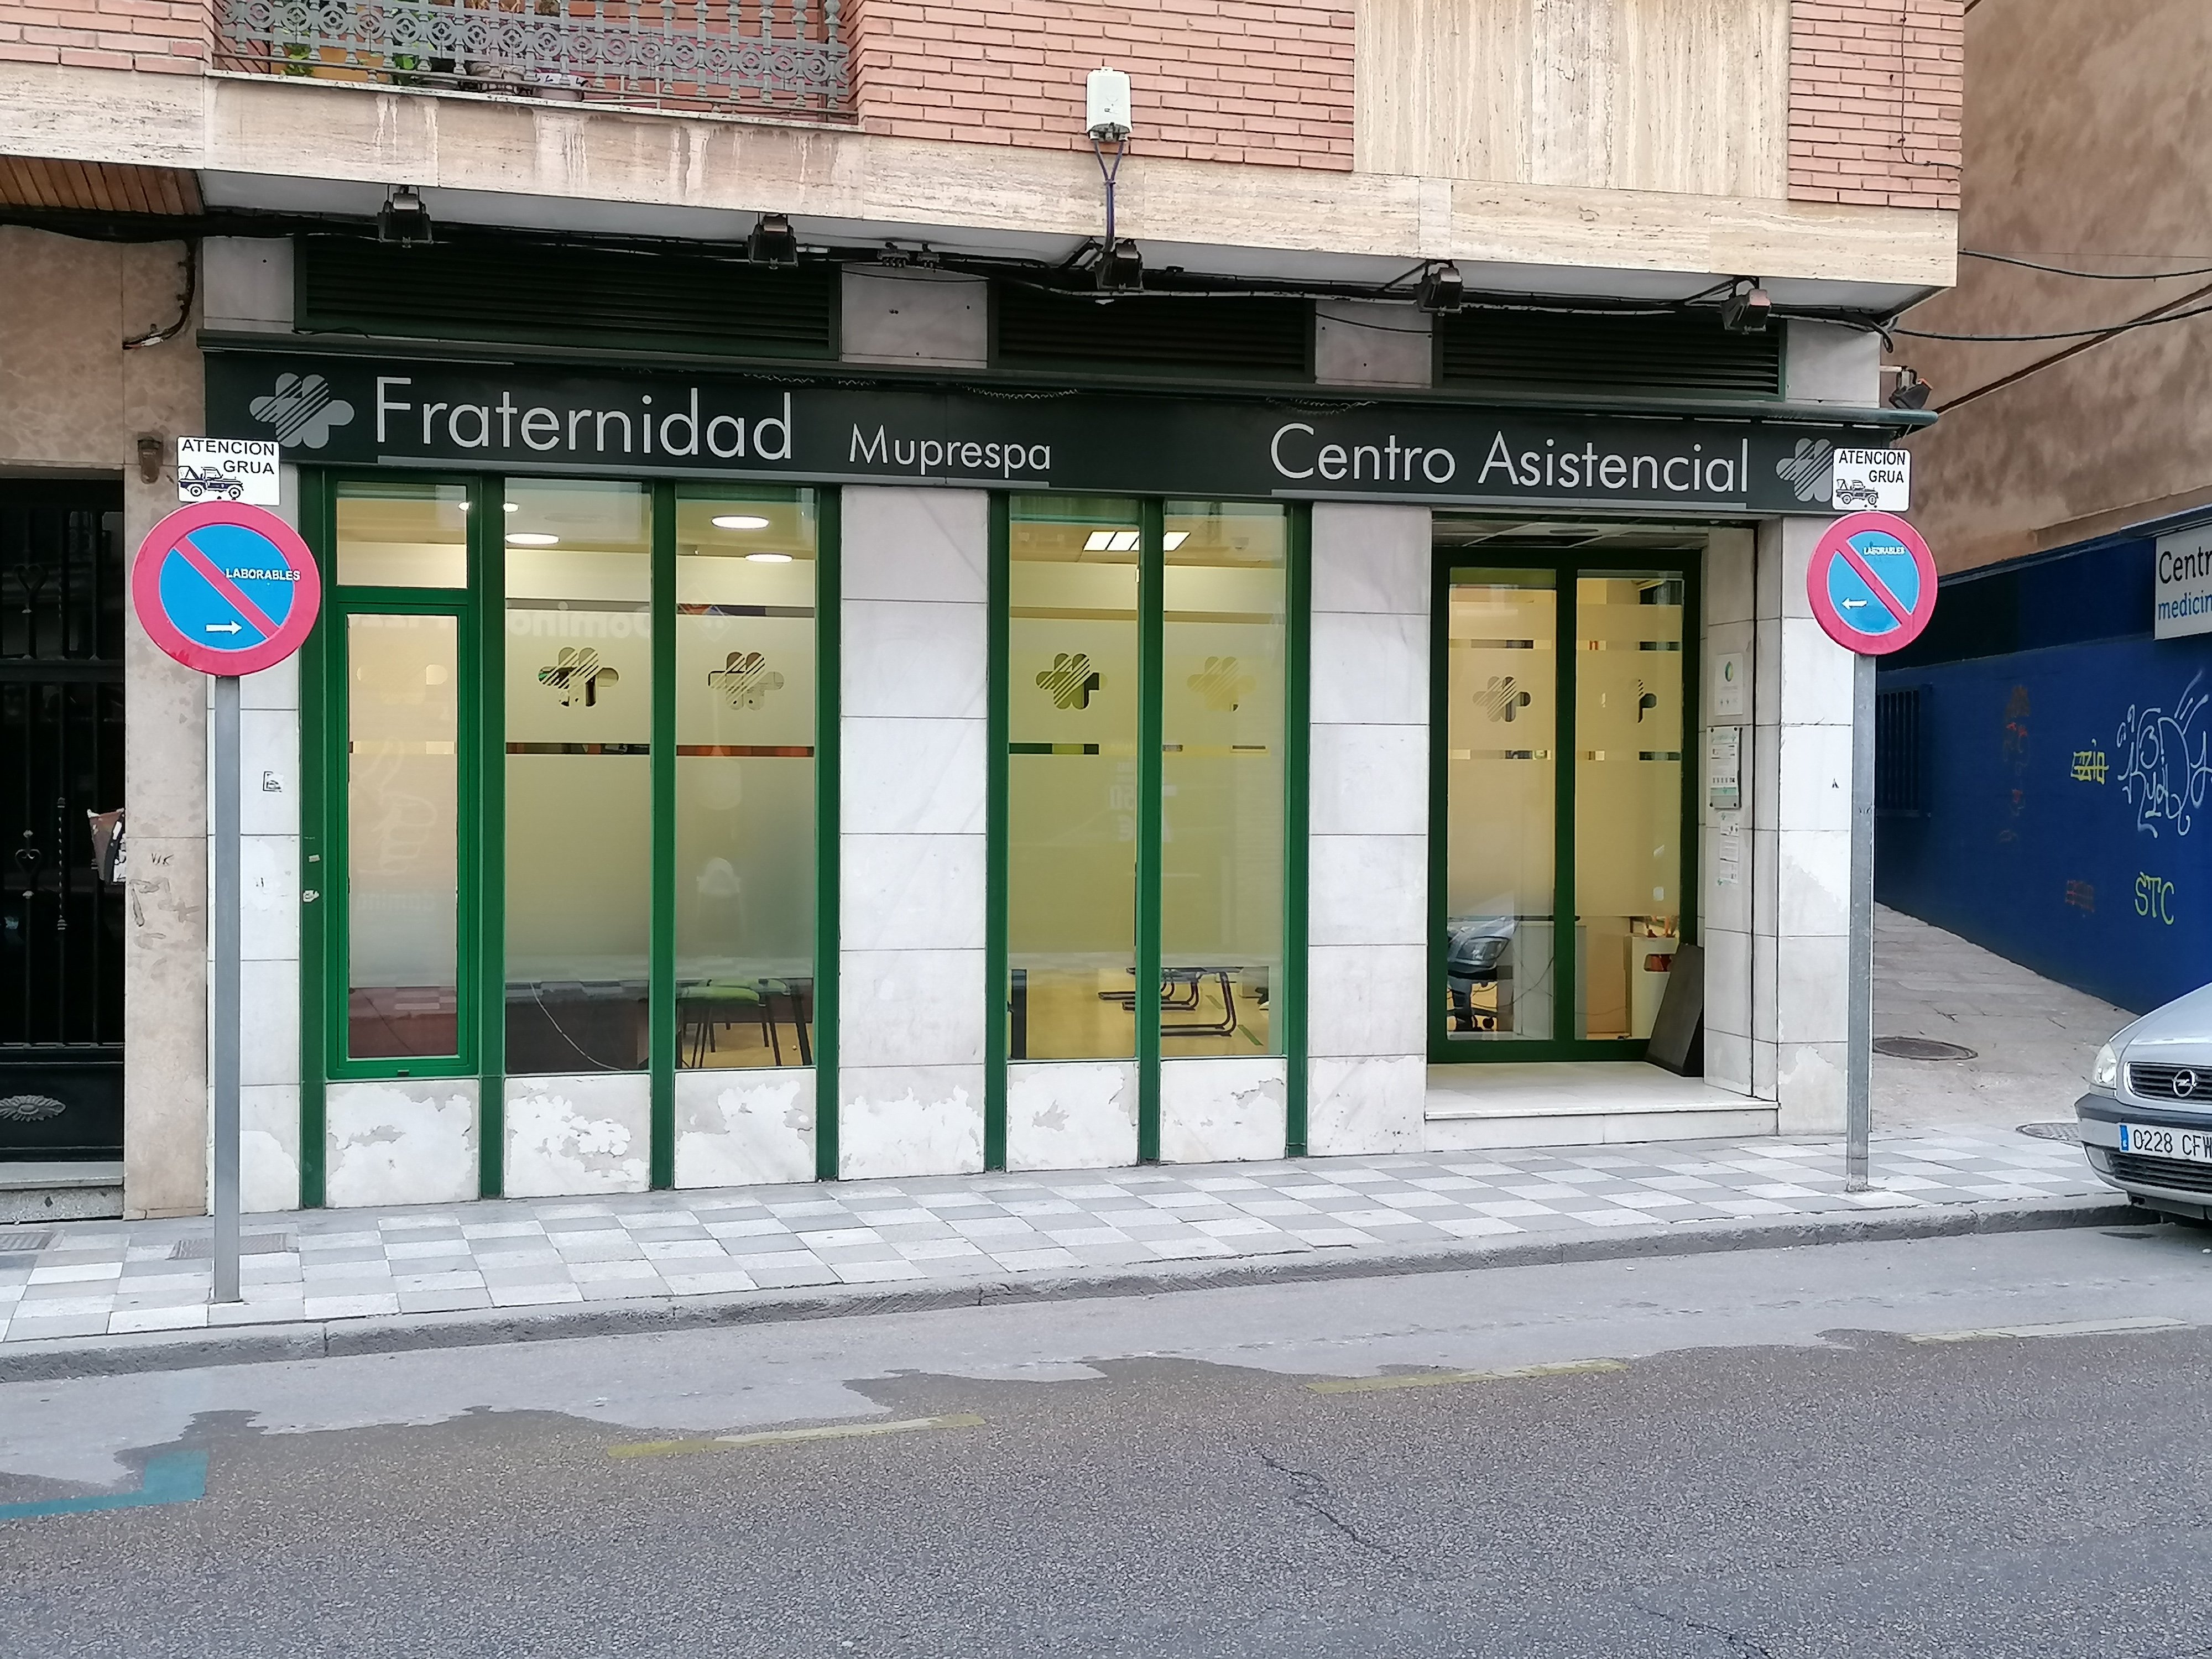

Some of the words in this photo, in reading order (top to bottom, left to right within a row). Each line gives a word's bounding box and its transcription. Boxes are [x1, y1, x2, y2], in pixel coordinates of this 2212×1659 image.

[376, 375, 792, 460] Fraternidad
[181, 439, 275, 456] ATENCION
[849, 423, 1051, 478] Muprespa
[1270, 422, 1457, 483] Centro
[1478, 430, 1748, 493] Asistencial
[1839, 450, 1906, 465] ATENCION
[223, 460, 274, 474] GRUA
[1869, 470, 1905, 483] GRUA
[1863, 546, 1906, 556] LABORABLES
[225, 567, 301, 581] LABORABLES
[2159, 546, 2212, 585] Centr
[2158, 590, 2212, 621] medicin
[2135, 871, 2174, 925] STC
[2133, 1129, 2173, 1154] 0228
